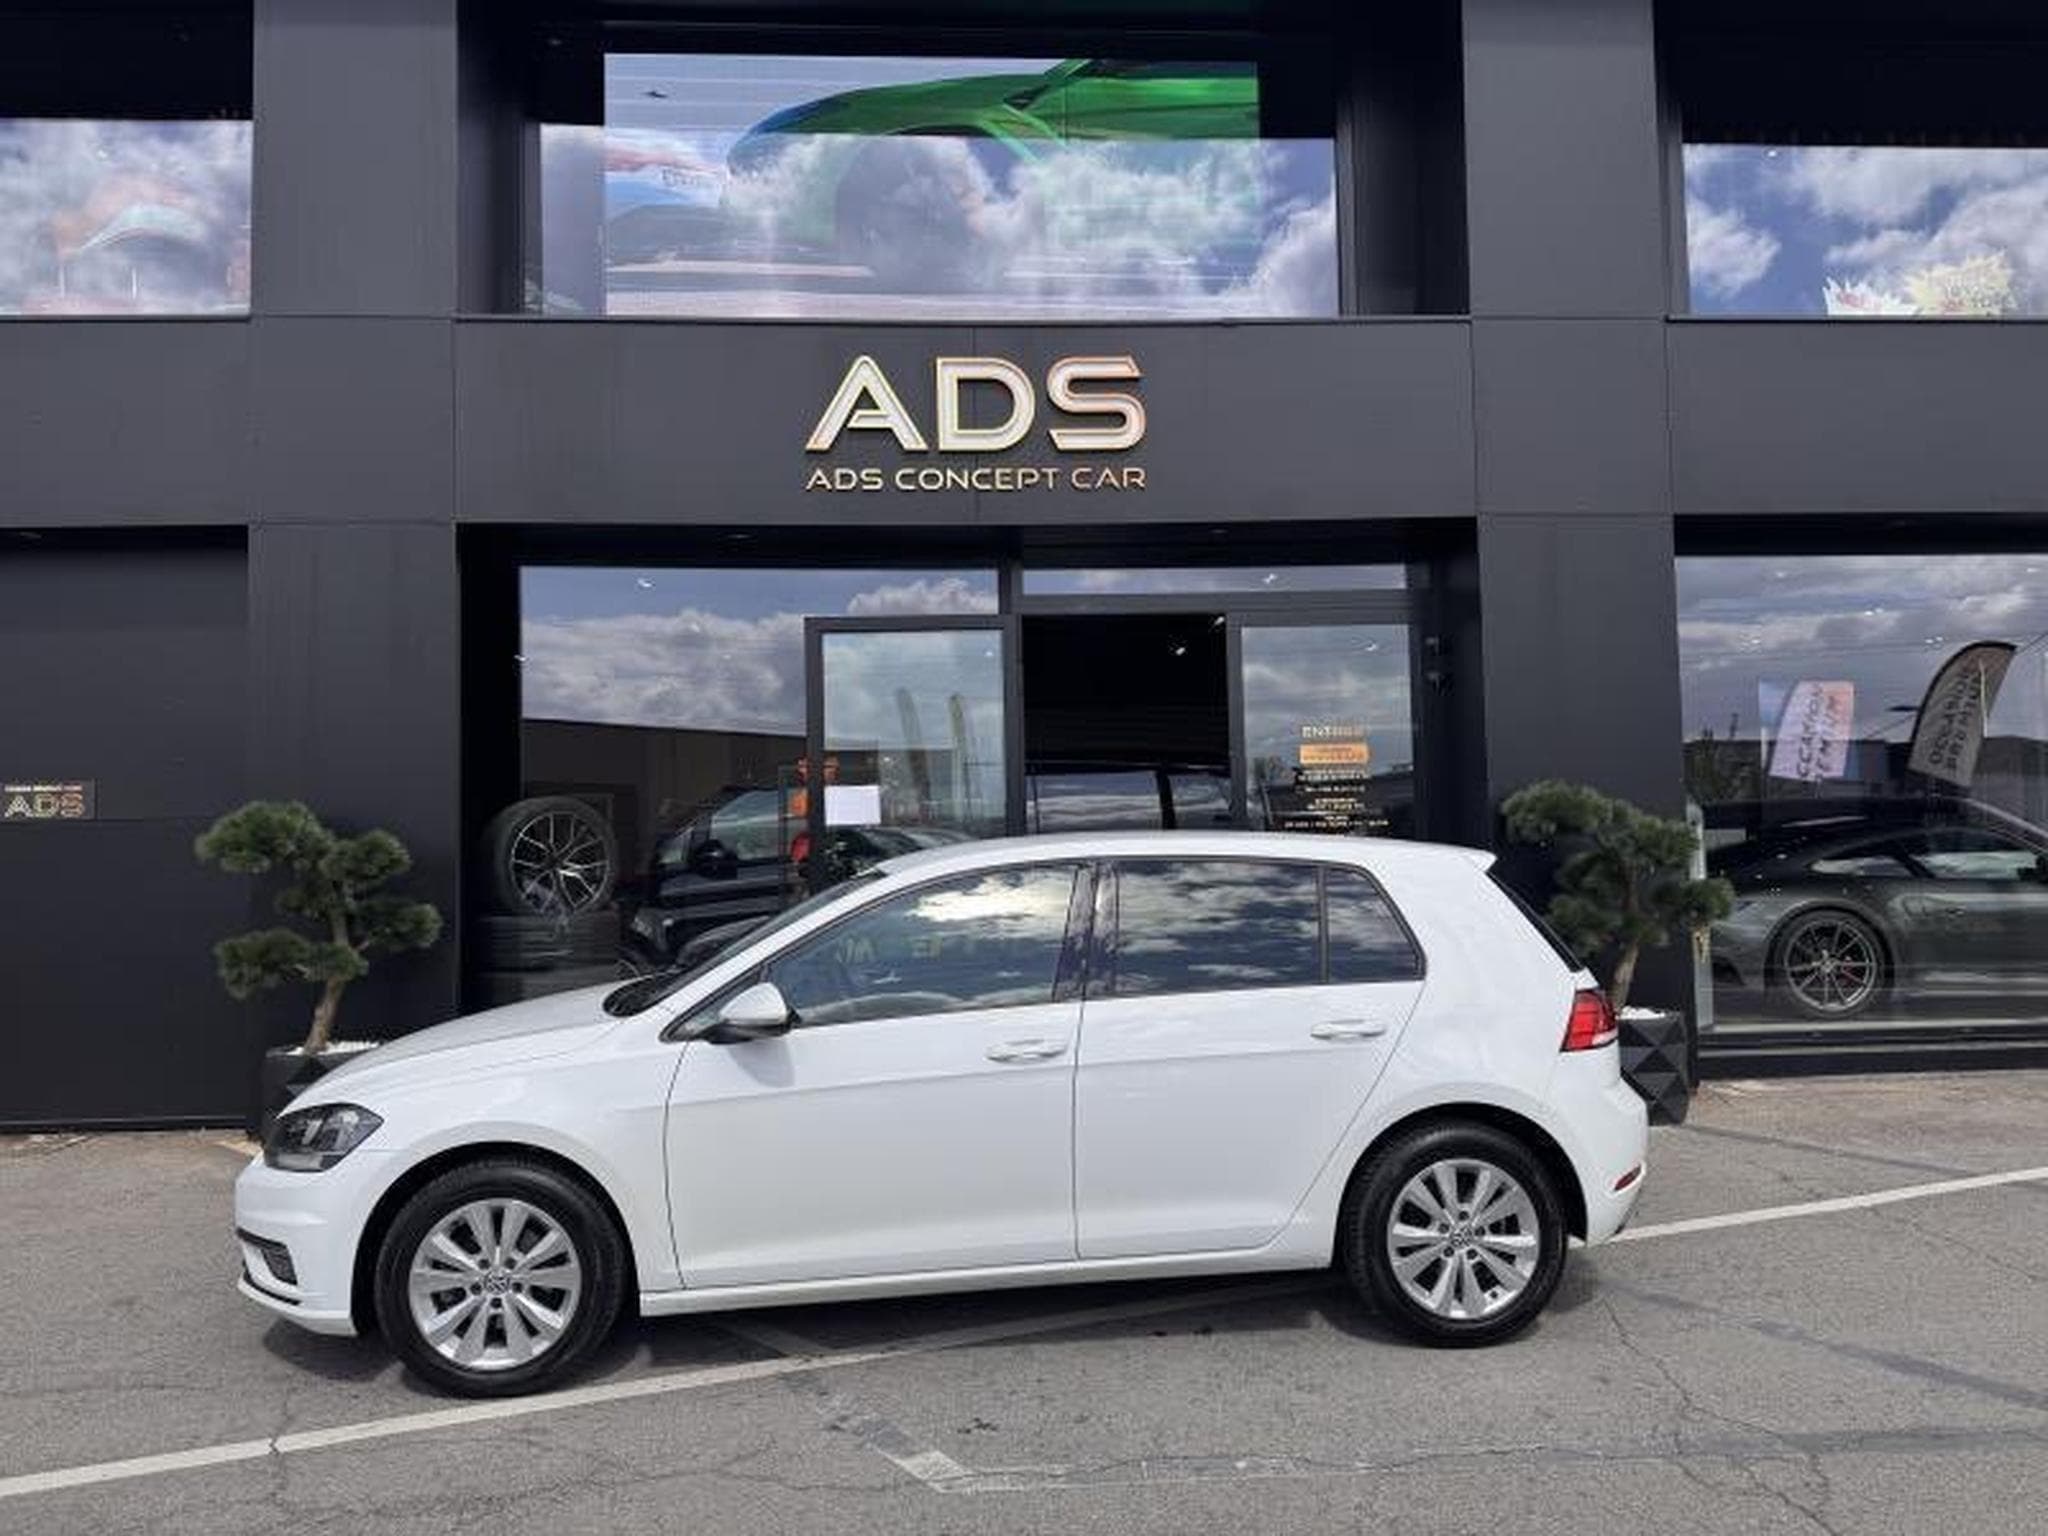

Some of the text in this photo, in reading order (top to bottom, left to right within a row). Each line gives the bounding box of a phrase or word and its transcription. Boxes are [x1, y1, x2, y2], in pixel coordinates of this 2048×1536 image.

[805, 354, 1147, 451] ADS
[805, 467, 1146, 490] ADS CONCEPT CAR
